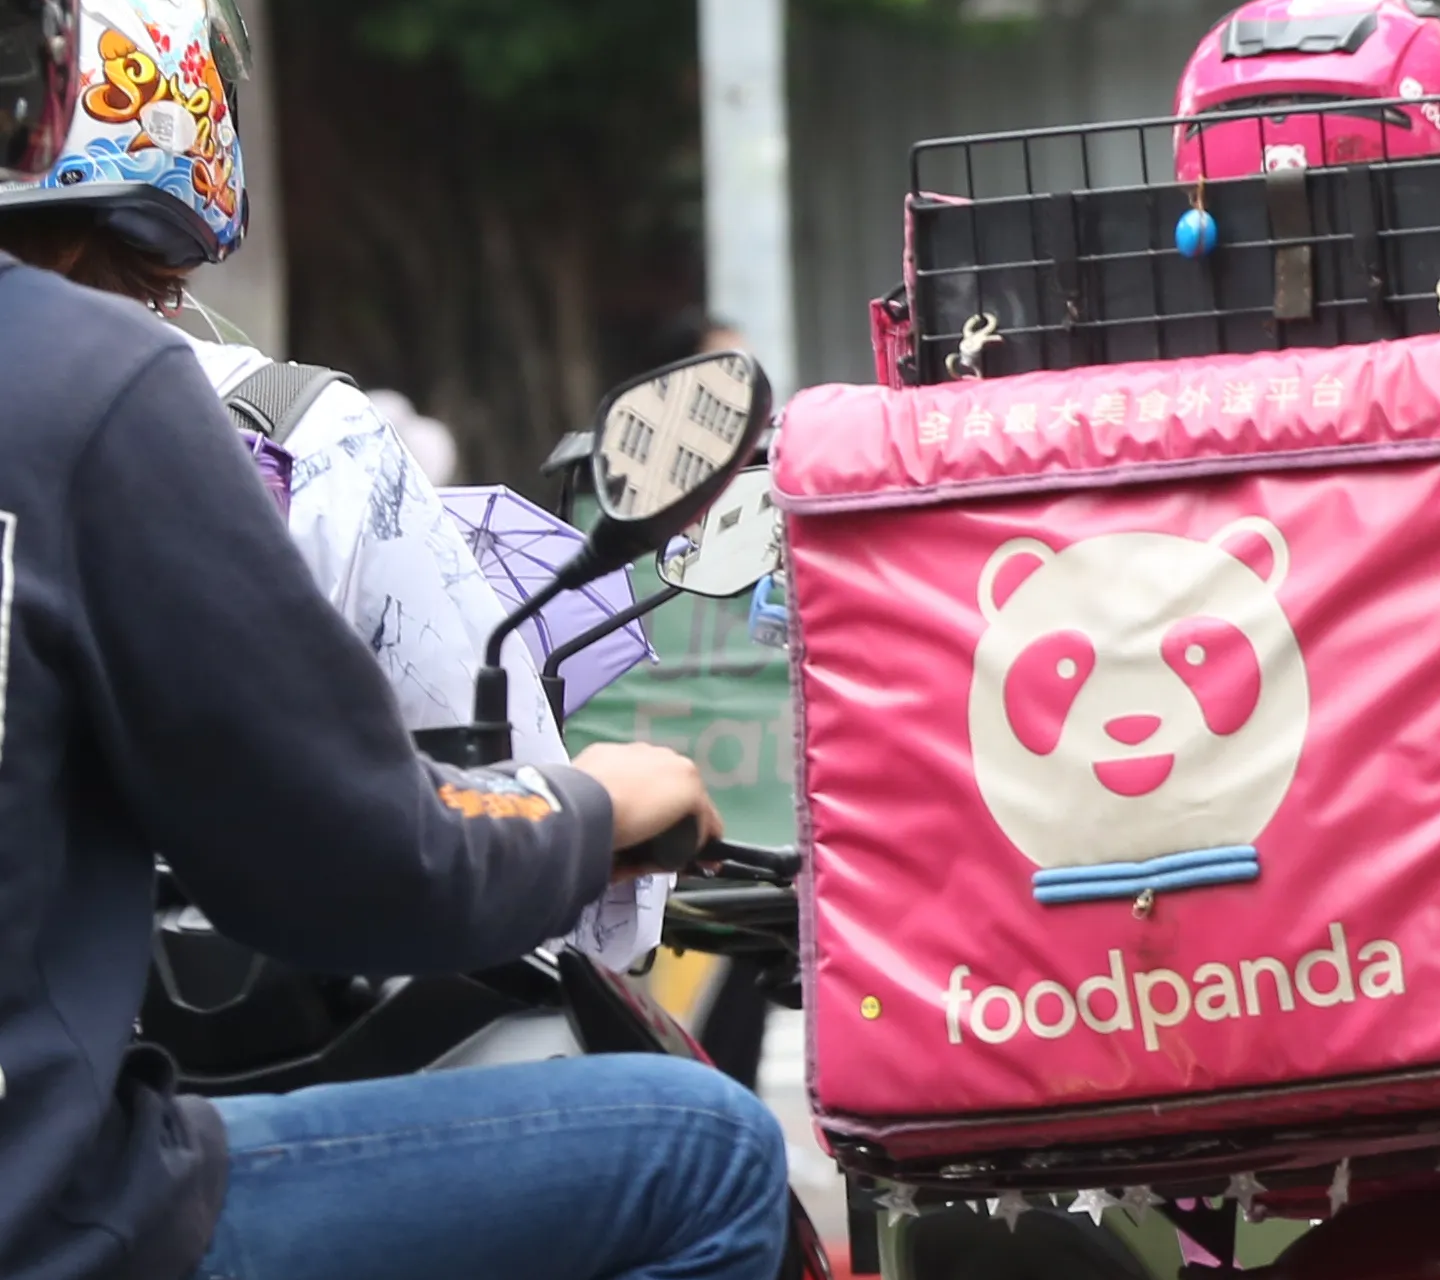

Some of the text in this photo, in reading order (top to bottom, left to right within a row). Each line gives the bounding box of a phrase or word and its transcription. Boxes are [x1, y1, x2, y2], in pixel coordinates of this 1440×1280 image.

[918, 375, 1347, 445] 全台最大美食外送平台
[942, 921, 1406, 1052] foodpanda
